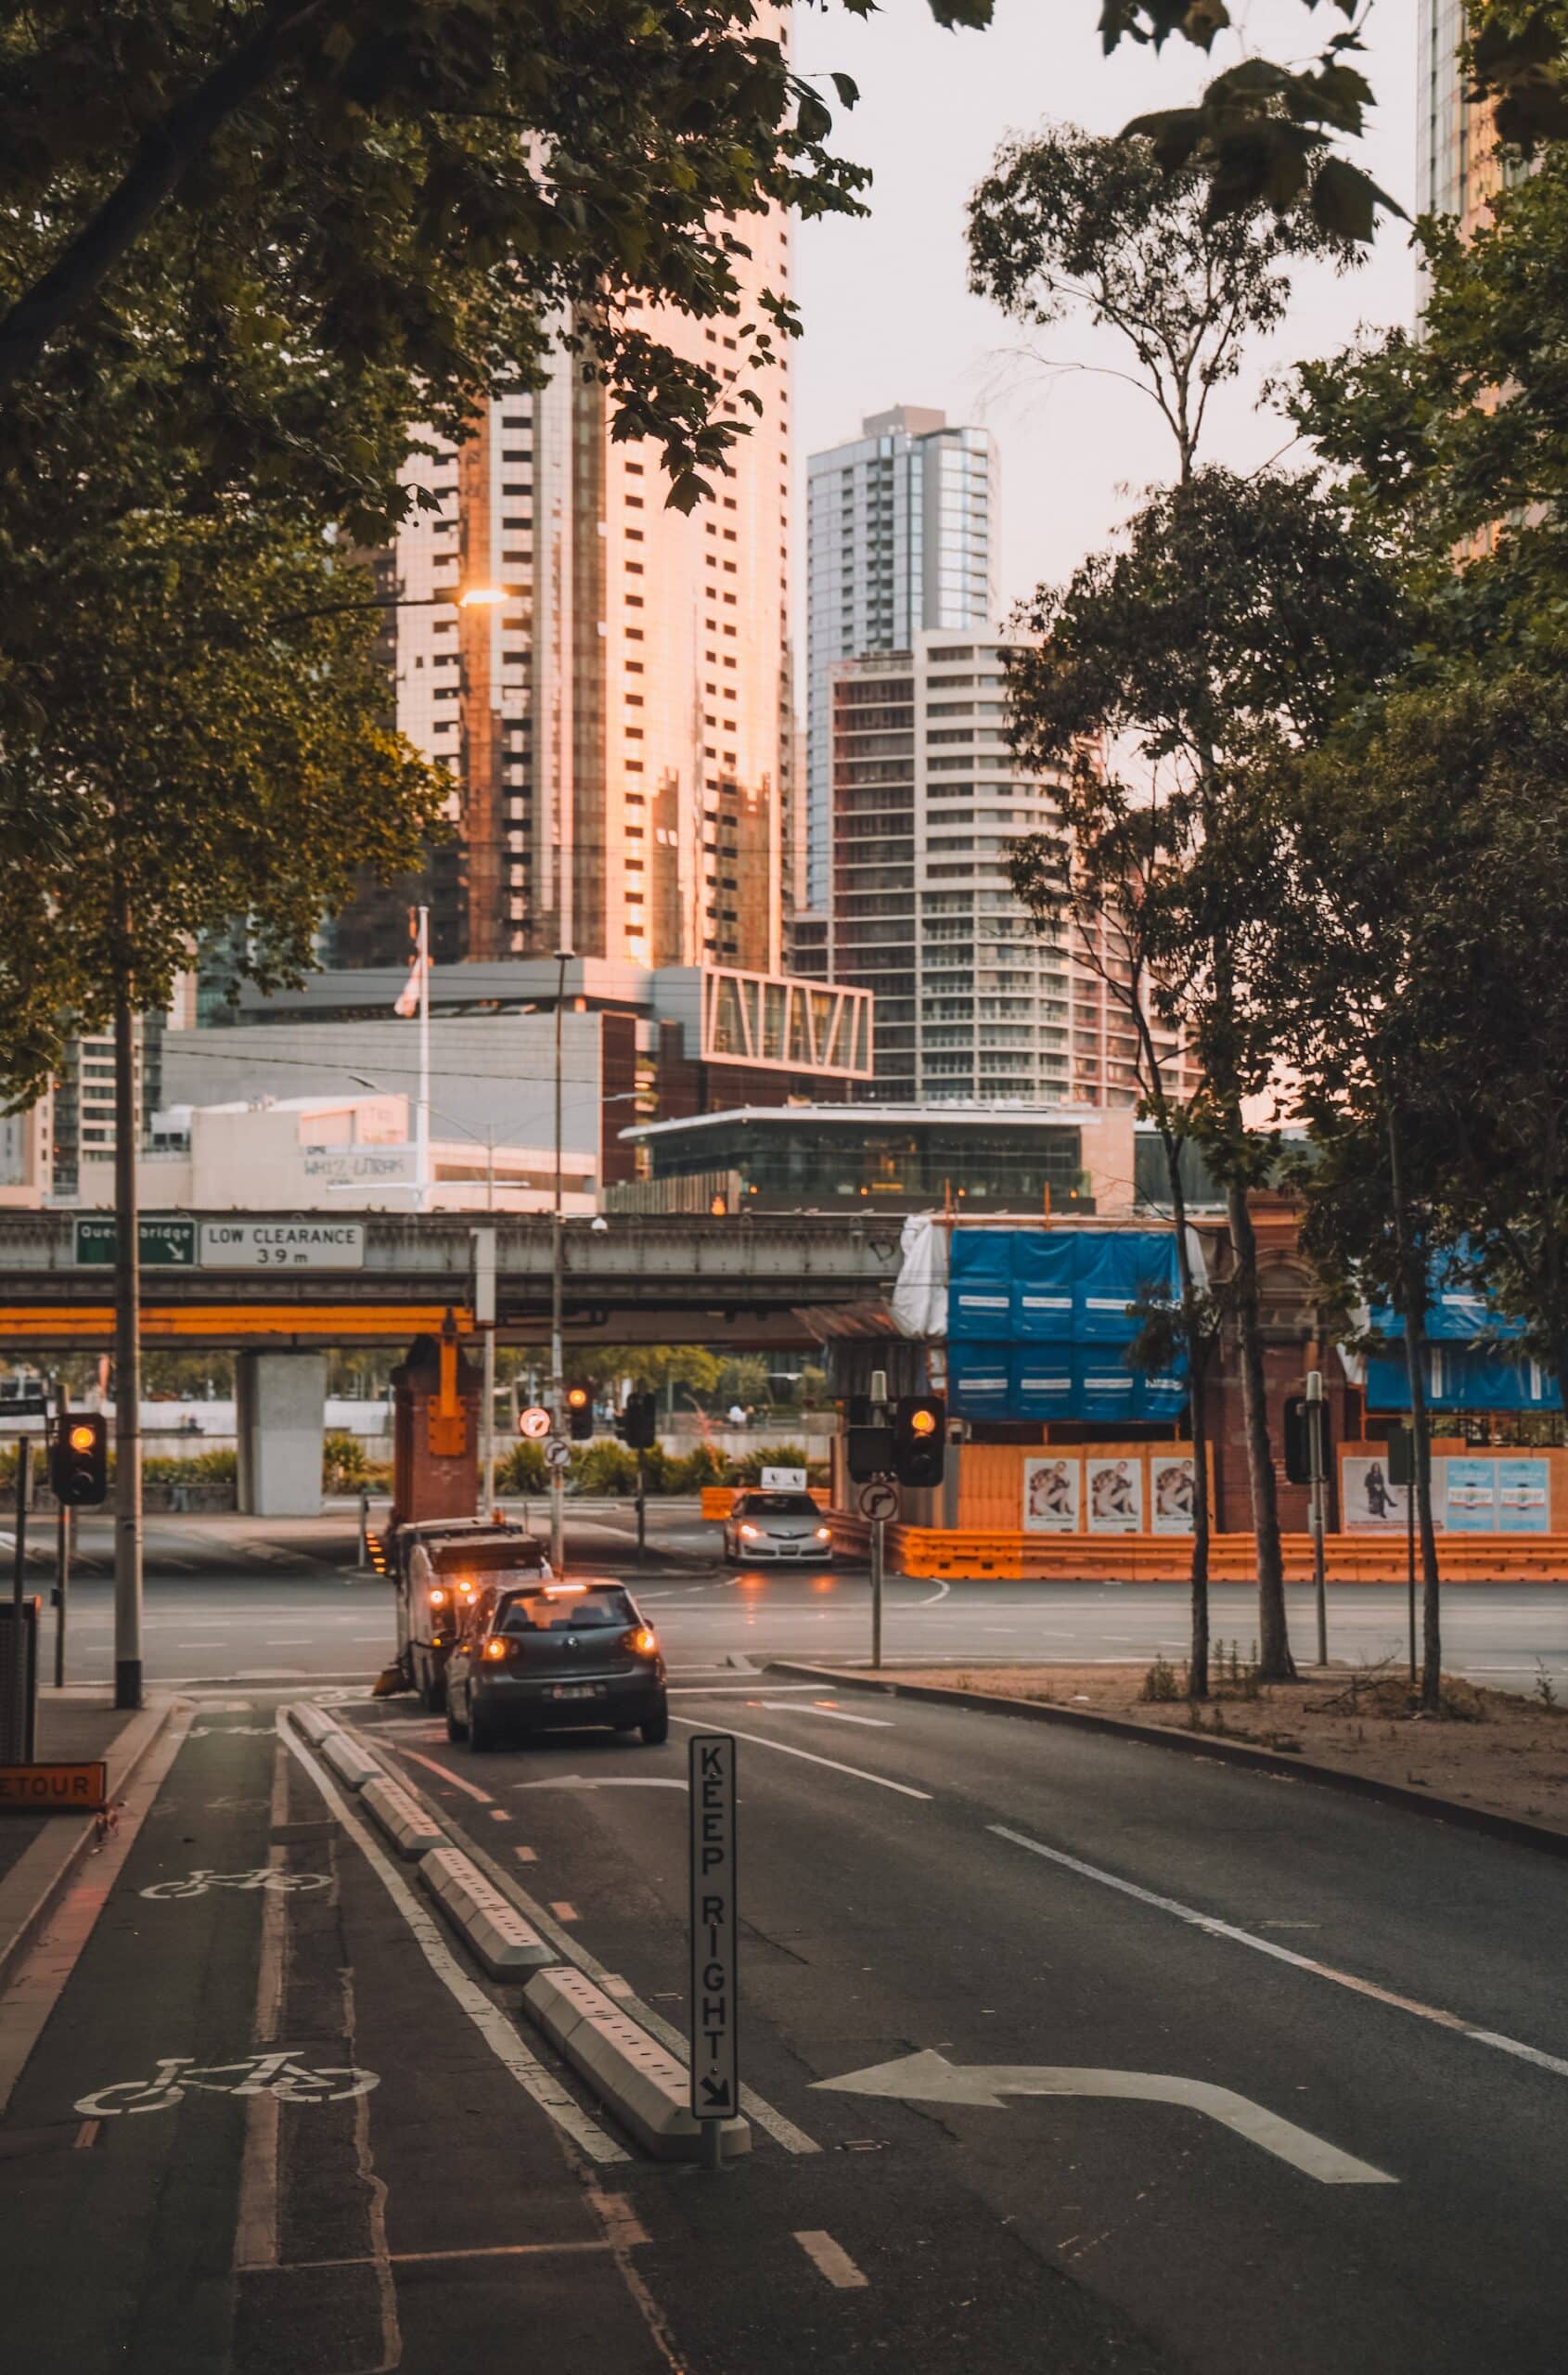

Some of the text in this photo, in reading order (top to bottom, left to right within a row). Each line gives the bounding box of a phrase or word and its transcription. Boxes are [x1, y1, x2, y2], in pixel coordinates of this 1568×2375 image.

[81, 1226, 191, 1242] Quebridge
[209, 1228, 356, 1244] LOW CLEARANCE
[293, 1253, 308, 1263] m
[700, 1747, 725, 2060] KEEP RIGHT
